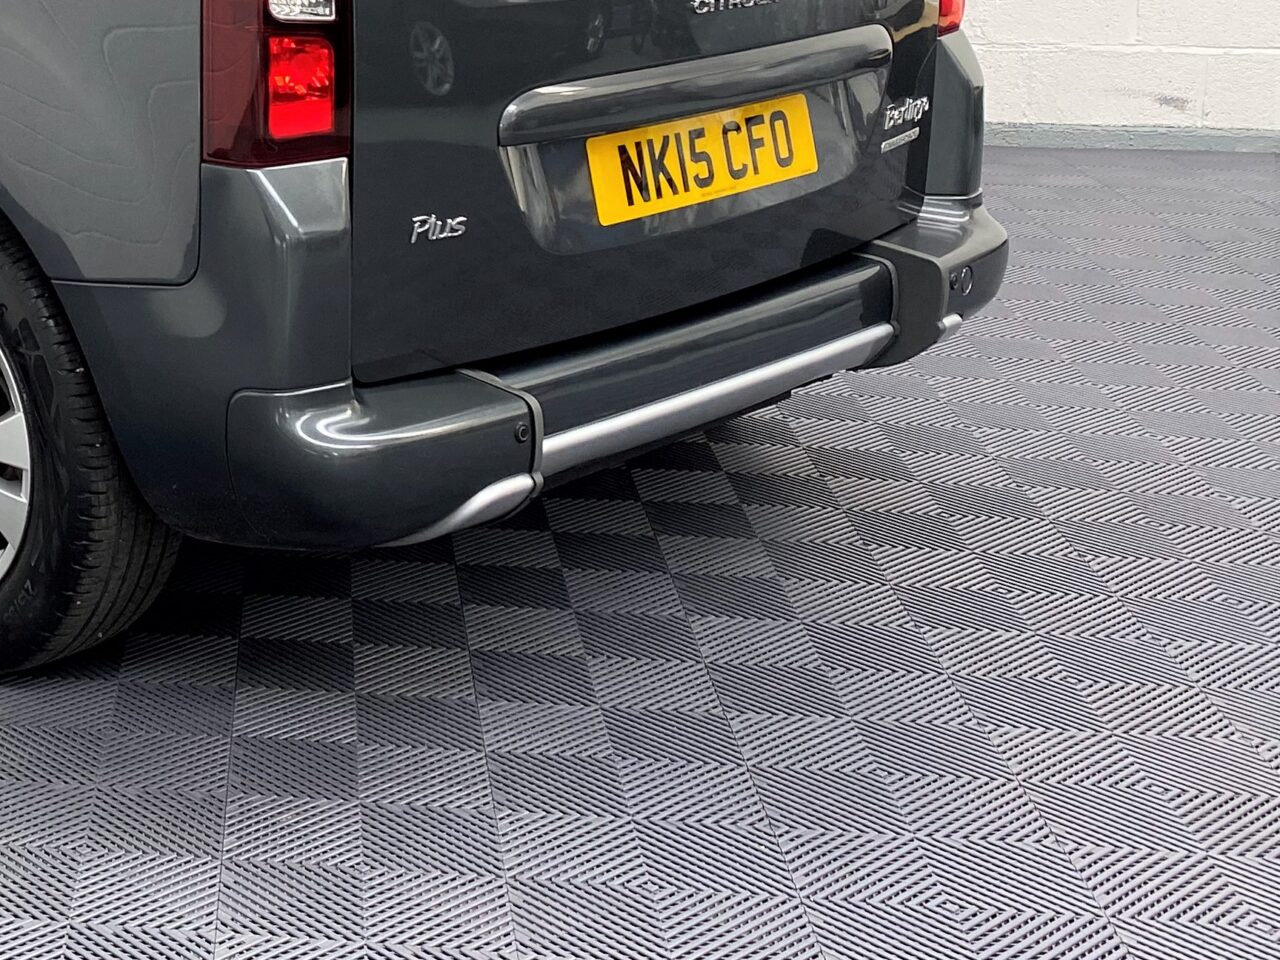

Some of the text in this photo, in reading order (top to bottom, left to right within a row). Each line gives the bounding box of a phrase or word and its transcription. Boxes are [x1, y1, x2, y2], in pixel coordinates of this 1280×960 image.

[617, 109, 795, 207] NK15 CFO
[410, 213, 468, 244] Plus
